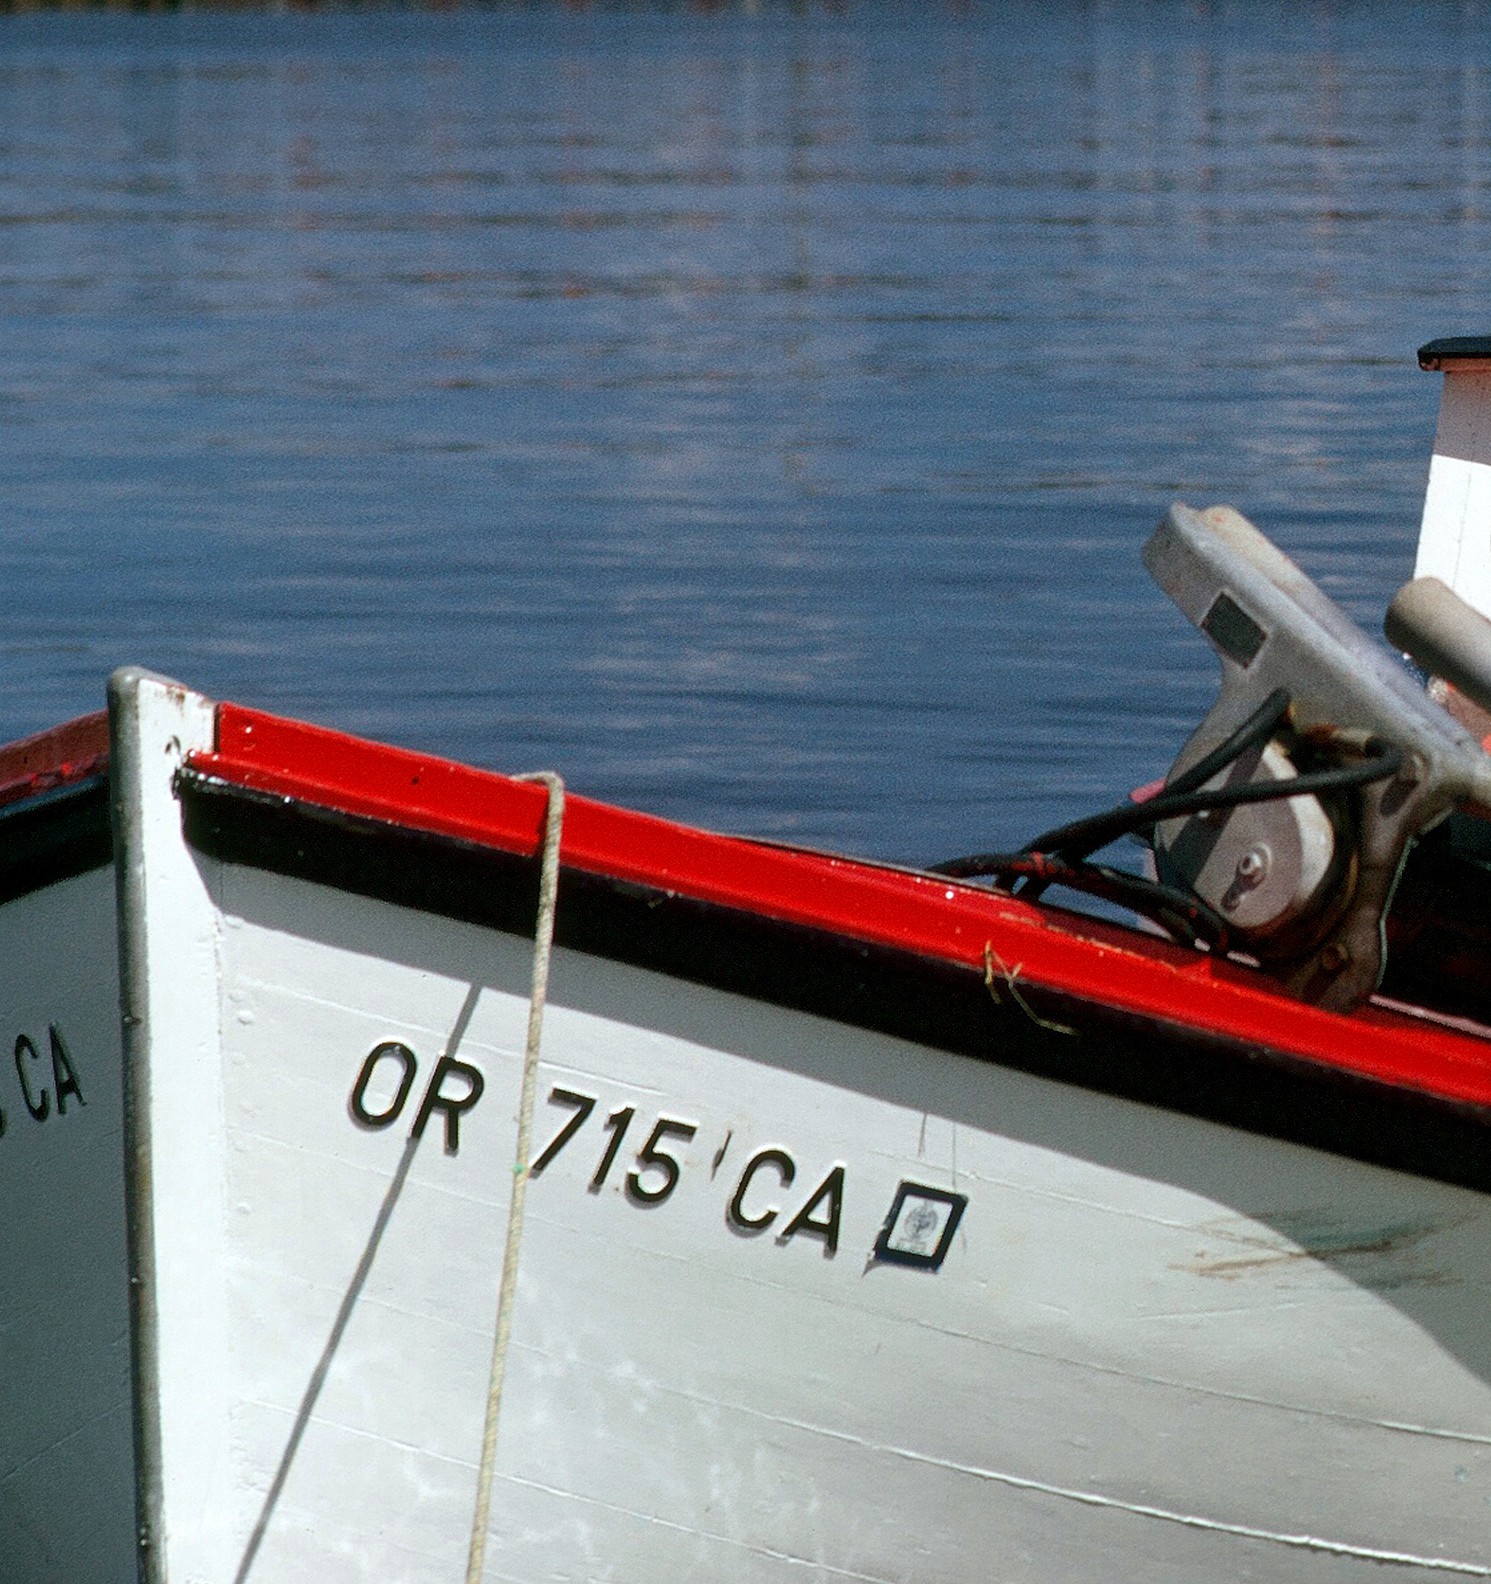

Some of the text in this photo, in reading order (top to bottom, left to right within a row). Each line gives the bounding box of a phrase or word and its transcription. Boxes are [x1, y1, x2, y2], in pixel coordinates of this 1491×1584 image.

[14, 1021, 87, 1122] CA
[351, 1041, 847, 1257] OR 715 CA
